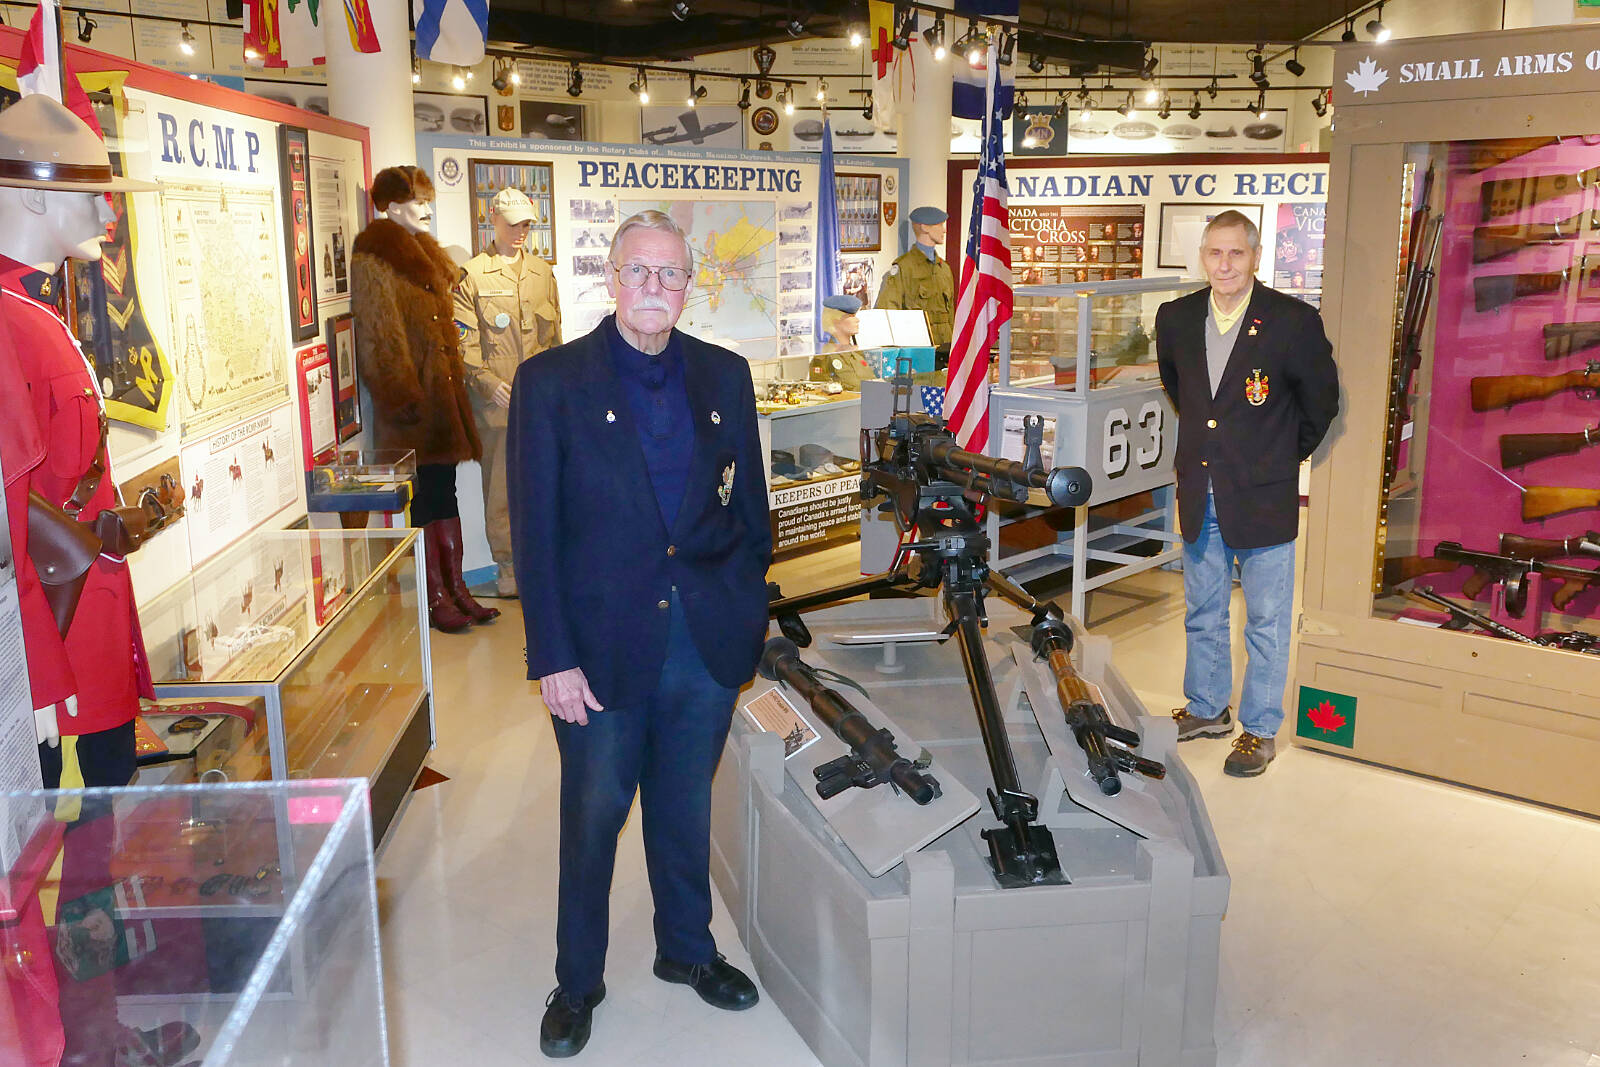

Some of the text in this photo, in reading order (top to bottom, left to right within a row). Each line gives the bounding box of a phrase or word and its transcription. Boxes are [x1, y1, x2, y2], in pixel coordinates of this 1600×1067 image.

[1400, 59, 1484, 83] SMALL
[1494, 52, 1573, 77] ARMS
[469, 139, 487, 147] This
[529, 143, 572, 152] sponsored
[587, 145, 599, 153] the
[602, 146, 626, 155] Rotary
[577, 160, 802, 193] PEACEKEEPING
[1169, 174, 1217, 196] VC
[1233, 172, 1326, 196] RECI
[1036, 229, 1086, 243] CROSS
[1103, 400, 1164, 480] 63
[775, 478, 861, 506] KEEPERS OF PEA
[778, 495, 852, 518] Canadians should be justly
[778, 517, 795, 529] proud
[796, 515, 803, 523] of
[803, 510, 829, 522] Canada's
[830, 507, 847, 516] armed
[778, 530, 784, 538] in
[785, 522, 818, 536] maintaining
[818, 519, 835, 531] peace
[836, 515, 847, 523] and
[778, 536, 799, 548] around
[799, 534, 809, 542] the
